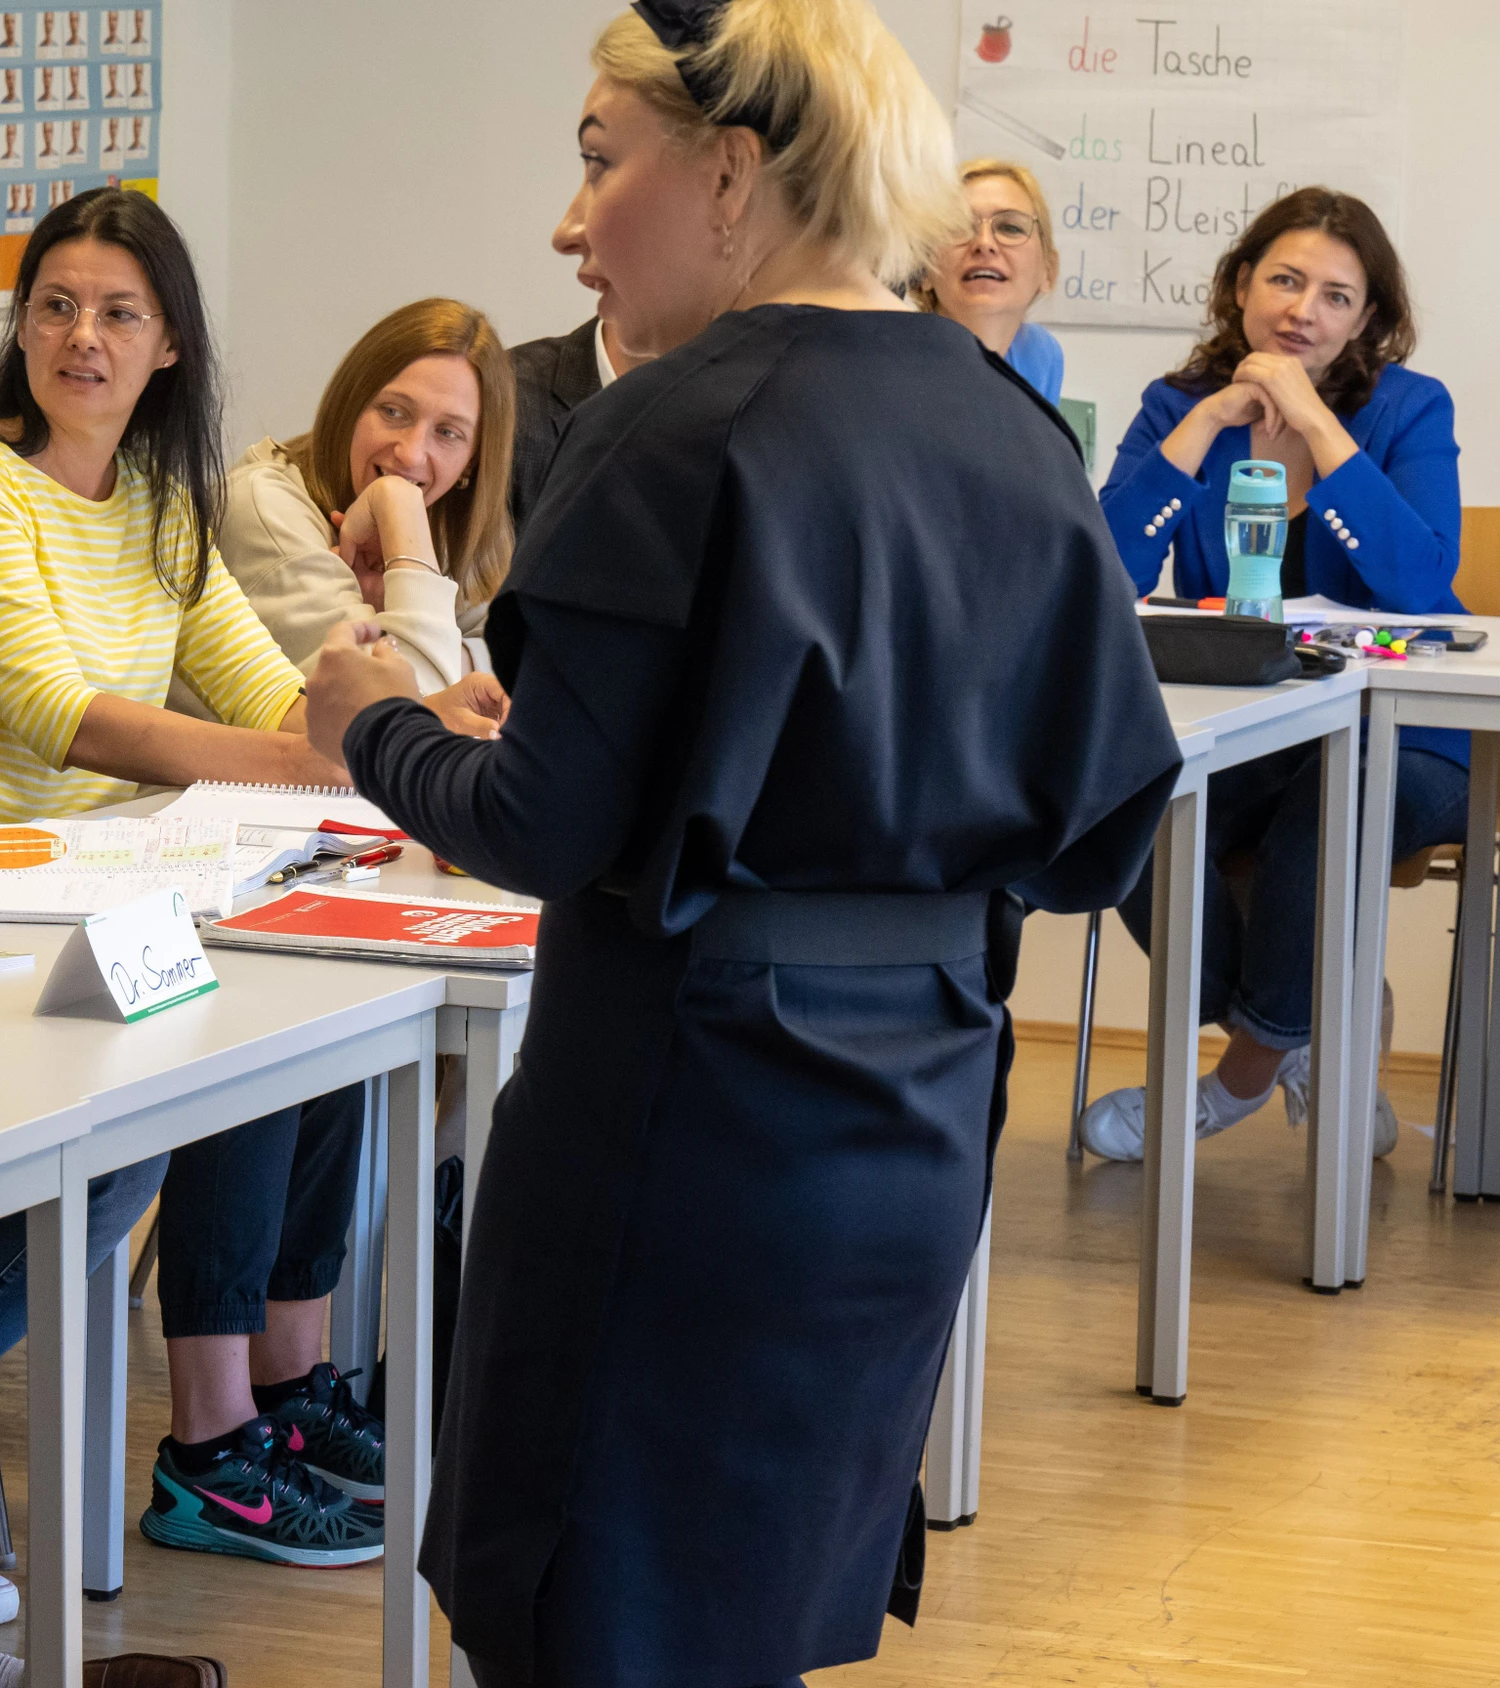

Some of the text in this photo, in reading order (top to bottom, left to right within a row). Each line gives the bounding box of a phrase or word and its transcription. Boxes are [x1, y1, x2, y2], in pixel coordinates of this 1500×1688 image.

[1068, 16, 1253, 78] die Tasche
[1069, 108, 1266, 168] das Lineal
[1062, 176, 1297, 237] der Bleist
[1064, 250, 1118, 301] der
[111, 962, 146, 1005] Dr.
[141, 945, 202, 991] Sommer
